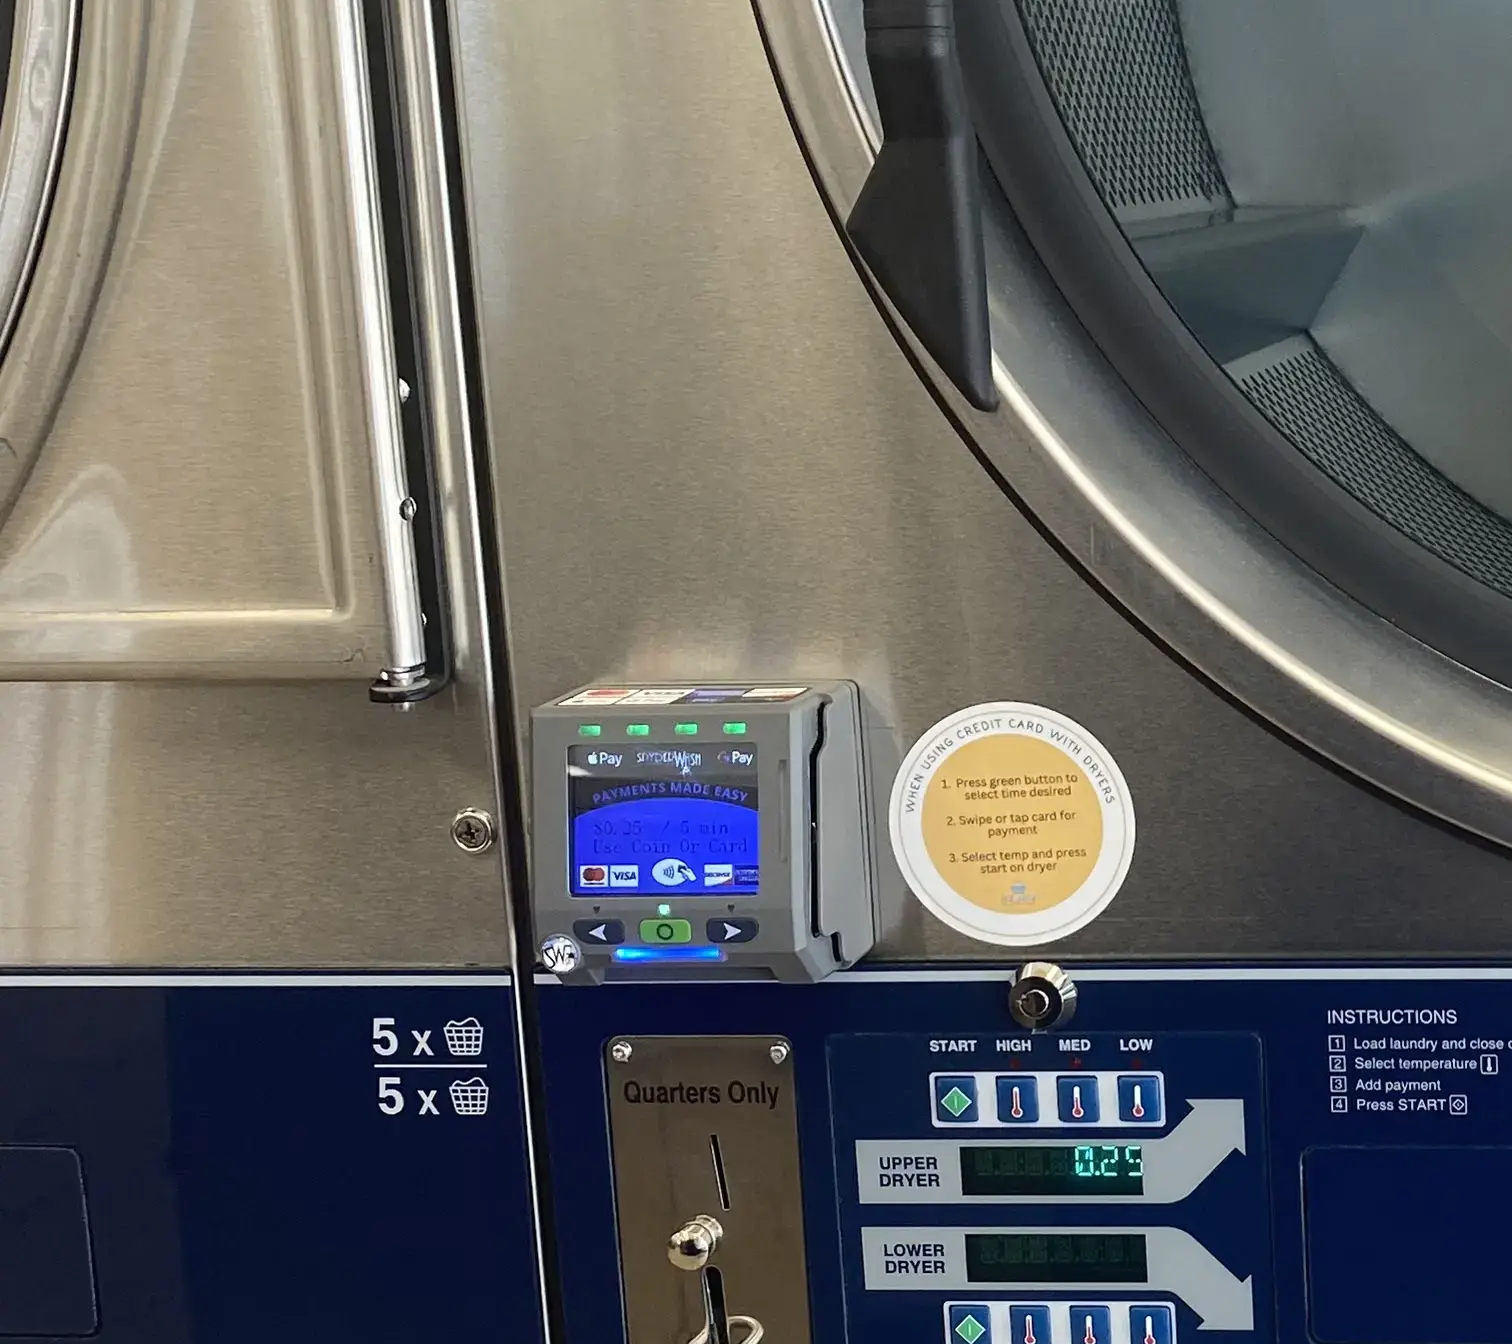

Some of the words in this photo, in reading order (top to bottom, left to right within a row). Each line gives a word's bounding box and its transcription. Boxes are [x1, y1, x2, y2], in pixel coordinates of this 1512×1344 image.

[600, 752, 623, 767] Pay
[905, 775, 925, 813] WHEN
[920, 738, 954, 771] USING
[956, 718, 1002, 740] CREDIT
[1008, 718, 1045, 735] CARD
[1050, 728, 1081, 756] WITH
[1083, 755, 1116, 805] DRYERS
[956, 778, 987, 789] Press
[989, 776, 1022, 790] green
[1024, 774, 1063, 785] button
[1065, 774, 1078, 784] to
[593, 782, 666, 805] PAYMENTS
[670, 782, 710, 796] MADE
[714, 786, 749, 803] EASY
[964, 789, 999, 801] select
[1001, 788, 1027, 799] time
[1029, 785, 1072, 798] desired
[959, 815, 993, 827] Swipe
[995, 815, 1007, 824] or
[1010, 812, 1029, 824] tap
[1031, 810, 1057, 822] card
[1060, 809, 1077, 820] for
[988, 824, 1038, 839] payment
[592, 839, 623, 854] Use
[631, 839, 671, 854] Coin
[679, 839, 701, 854] Or
[708, 839, 748, 854] Card
[961, 851, 997, 863] Select
[999, 849, 1029, 862] temp
[1031, 848, 1053, 859] and
[1056, 847, 1087, 859] press
[980, 862, 1008, 874] start
[1009, 863, 1024, 873] on
[1026, 861, 1058, 874] dryer
[612, 871, 637, 881] VISA
[1327, 1009, 1458, 1025] INSTRUCTIONS
[372, 1017, 399, 1057] 5
[1354, 1037, 1387, 1050] Load
[1389, 1037, 1438, 1053] laundry
[1441, 1037, 1466, 1050] and
[1469, 1037, 1505, 1050] close
[929, 1039, 978, 1053] START
[996, 1039, 1032, 1053] HIGH
[1058, 1038, 1091, 1052] MED
[1119, 1038, 1153, 1052] LOW
[1354, 1057, 1396, 1070] Select
[1398, 1057, 1478, 1073] temperature
[1355, 1078, 1382, 1091] Add
[1385, 1078, 1442, 1094] payment
[378, 1076, 405, 1116] 5
[623, 1080, 721, 1105] Quarters
[727, 1080, 779, 1110] Only
[1356, 1098, 1395, 1111] Press
[1398, 1098, 1447, 1111] START
[879, 1156, 938, 1171] UPPER
[1074, 1145, 1144, 1177] 0.25
[879, 1173, 940, 1188] DRYER
[883, 1243, 945, 1258] LOWER
[885, 1260, 946, 1275] DRYER
